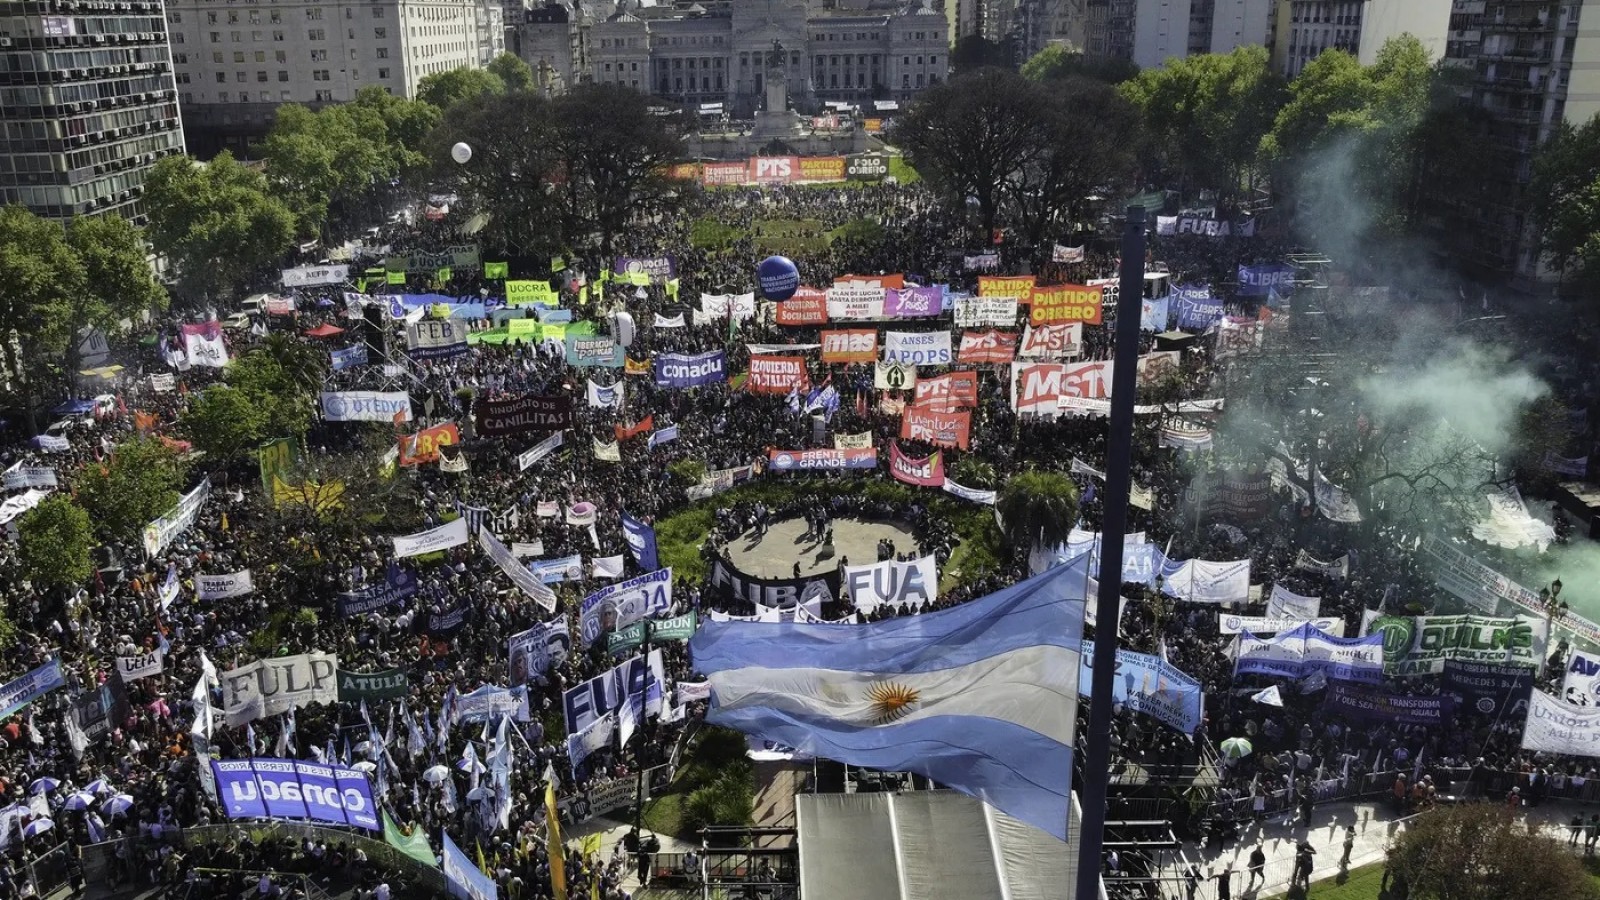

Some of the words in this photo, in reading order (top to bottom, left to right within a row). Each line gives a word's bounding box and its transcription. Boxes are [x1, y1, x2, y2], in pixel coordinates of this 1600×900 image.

[757, 158, 791, 176] PTS
[801, 160, 843, 169] PARTIDO
[419, 255, 455, 267] UOCRA
[643, 258, 670, 268] UOCRA
[980, 280, 1033, 290] PARTIDO
[1250, 269, 1295, 286] LIBRES
[509, 284, 547, 293] UOCRA
[982, 289, 1031, 299] OBRERO
[783, 300, 820, 309] IZQUIERDA
[1033, 290, 1101, 306] PARTIDO
[782, 311, 822, 320] SOCIALISTA
[1032, 306, 1096, 321] OBRERO
[416, 322, 453, 338] FEB
[823, 332, 876, 352] mas
[902, 336, 935, 345] ANSES
[960, 333, 998, 351] PTS
[887, 349, 950, 363] APOPS
[662, 359, 722, 378] conadu
[752, 360, 800, 374] IZQUIERDA
[489, 398, 539, 415] SINDICATO
[542, 401, 556, 409] DE
[484, 412, 564, 429] CANILLITAS
[799, 459, 847, 467] GRANDE
[801, 451, 845, 459] FRENTE
[364, 581, 393, 599] ATSA
[582, 586, 615, 613] SERGIO
[622, 569, 669, 588] ROMERO
[849, 565, 928, 605] FUA
[345, 588, 402, 614] HURLINGHAM
[1421, 626, 1533, 651] QUILMS
[228, 660, 335, 707] FULP
[343, 673, 405, 691] ATULP
[1451, 674, 1496, 687] MERCEDES
[1127, 688, 1162, 706] WALTER
[1335, 694, 1340, 702] Y
[1342, 697, 1356, 706] QUE
[1358, 700, 1373, 710] SEA
[1336, 686, 1345, 694] LA
[1390, 698, 1440, 708] TRANSFORMA
